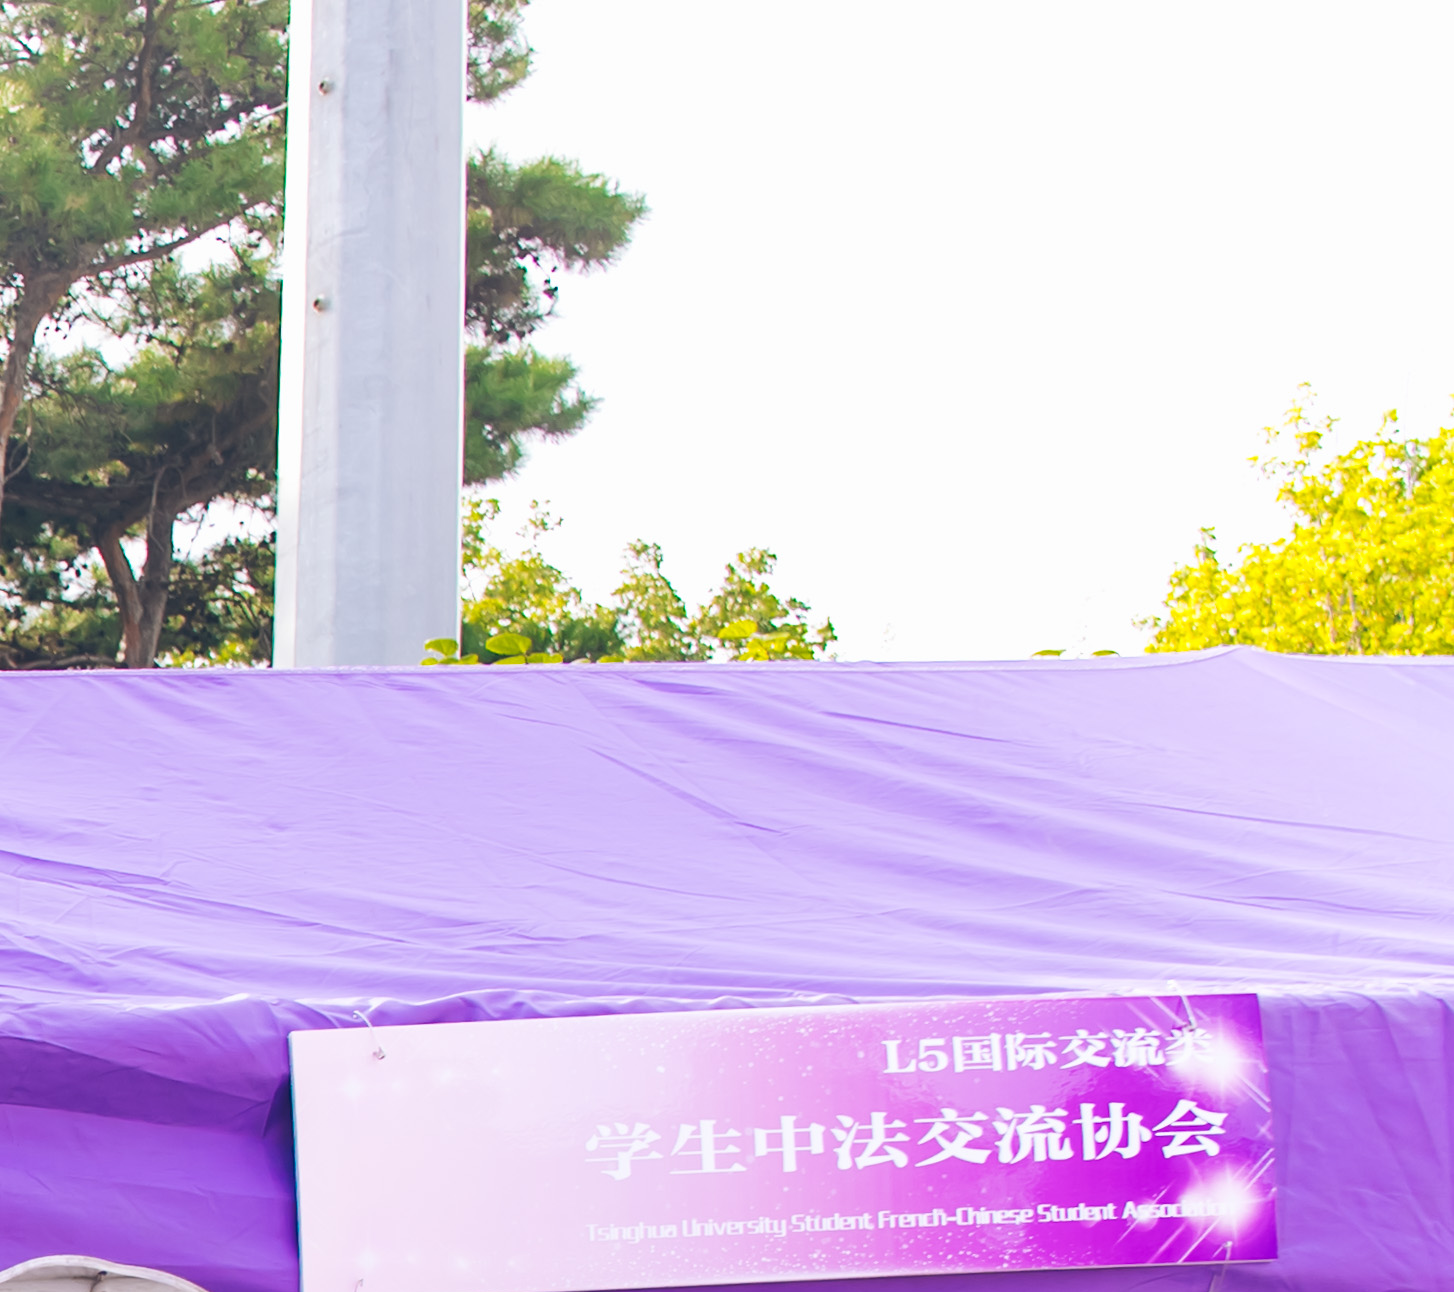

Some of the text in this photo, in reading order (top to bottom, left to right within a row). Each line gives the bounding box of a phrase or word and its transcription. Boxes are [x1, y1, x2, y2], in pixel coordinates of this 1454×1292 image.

[882, 1028, 1218, 1076] L5国际交流类
[584, 1098, 1230, 1182] 学生中法交流协会
[586, 1222, 678, 1245] Tsinghua
[681, 1215, 788, 1239] University
[790, 1210, 875, 1232] Student
[877, 1207, 1035, 1229] French-Chinese
[1037, 1203, 1119, 1222] Student
